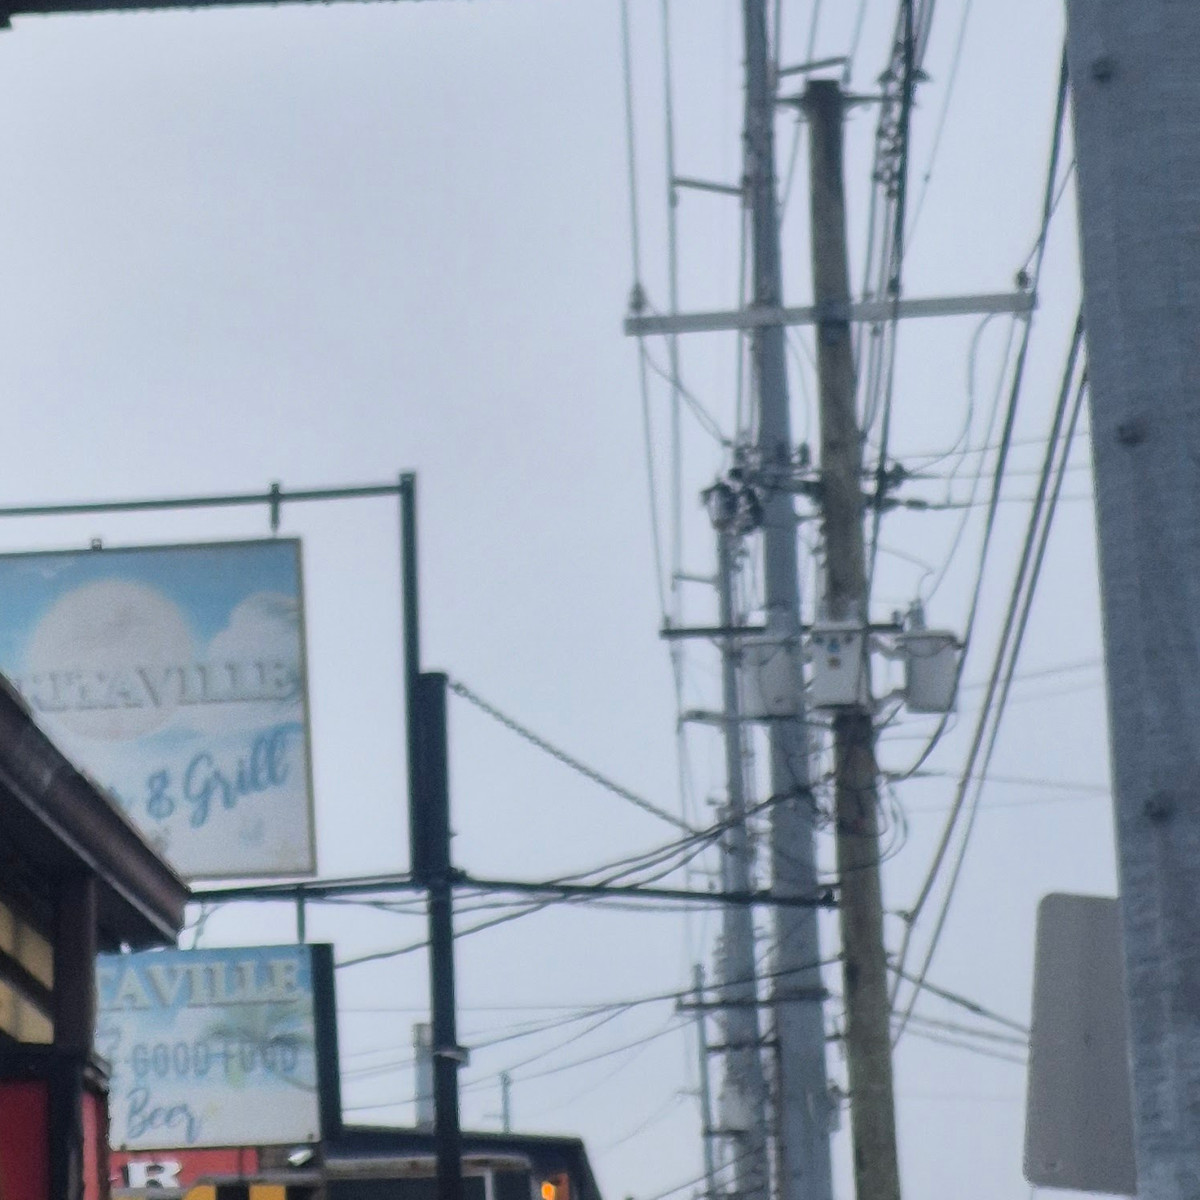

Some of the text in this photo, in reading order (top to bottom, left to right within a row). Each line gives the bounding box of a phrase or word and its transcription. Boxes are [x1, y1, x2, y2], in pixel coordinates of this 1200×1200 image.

[183, 721, 302, 829] Grill
[132, 1040, 300, 1080] GOOD FOOD
